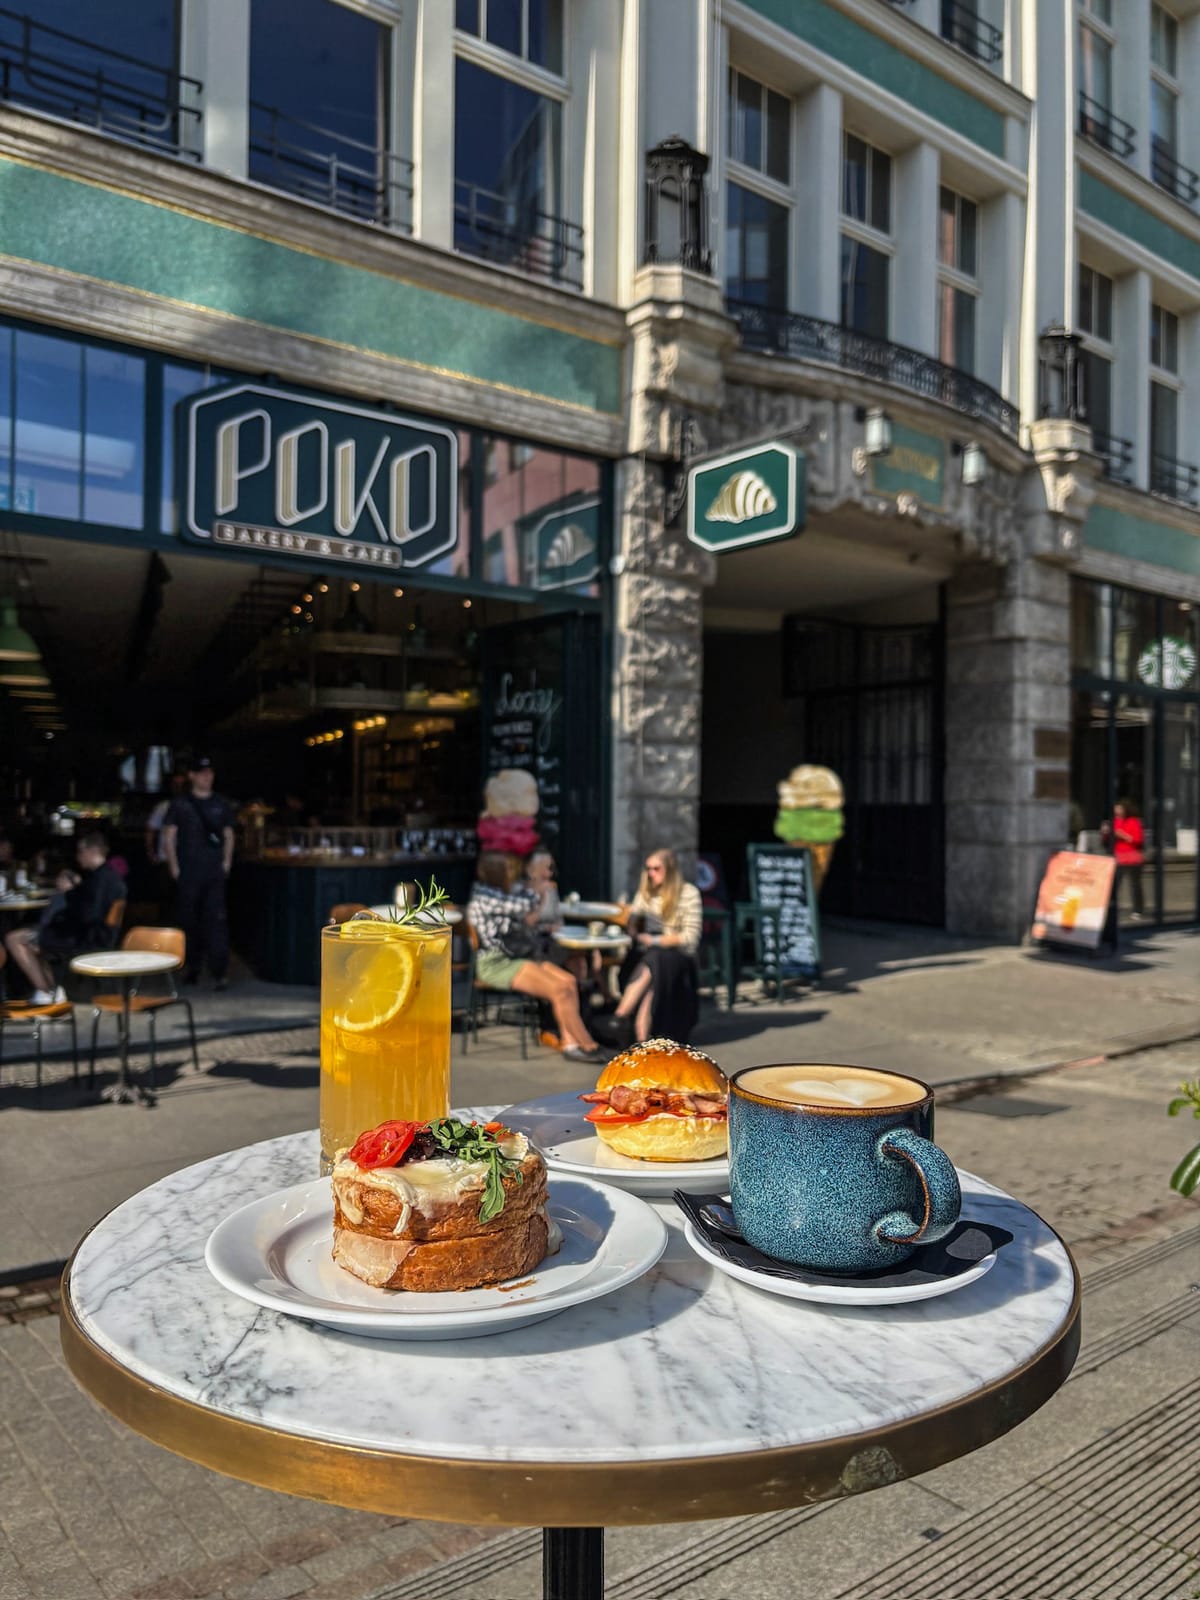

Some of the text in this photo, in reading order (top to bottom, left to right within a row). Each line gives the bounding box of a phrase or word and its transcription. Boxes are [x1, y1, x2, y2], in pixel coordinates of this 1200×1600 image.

[216, 409, 437, 545] POKO
[223, 524, 394, 565] BAKERY & CAFE
